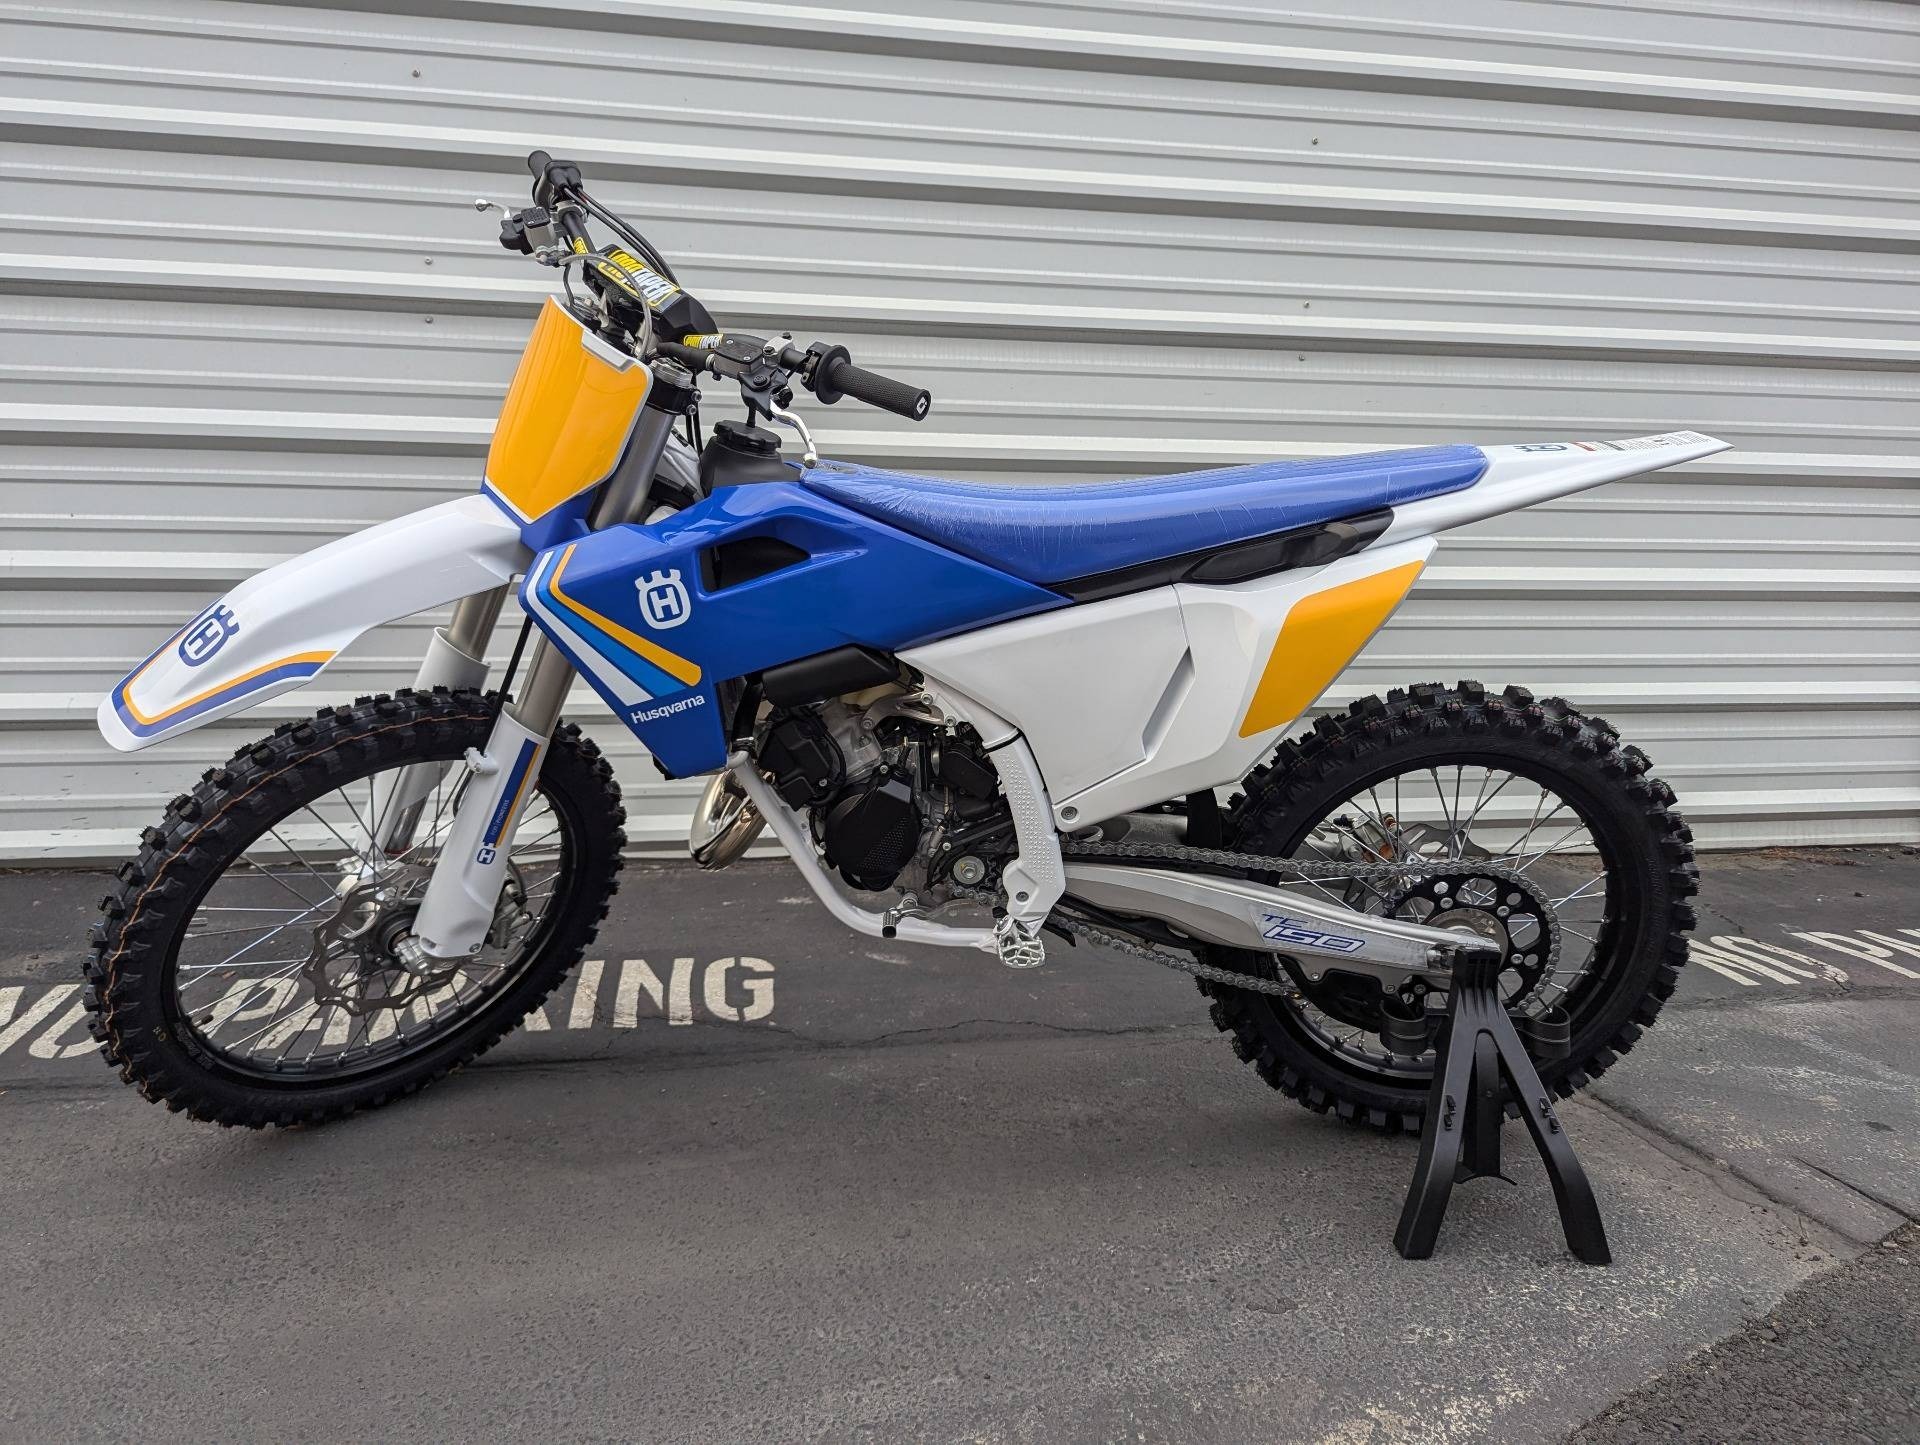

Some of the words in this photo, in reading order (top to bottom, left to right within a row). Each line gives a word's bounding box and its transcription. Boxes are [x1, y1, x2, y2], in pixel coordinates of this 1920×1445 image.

[630, 695, 706, 725] Husqvarna
[1262, 913, 1309, 928] TC
[1262, 924, 1366, 953] 150
[201, 956, 776, 1051] PARING
